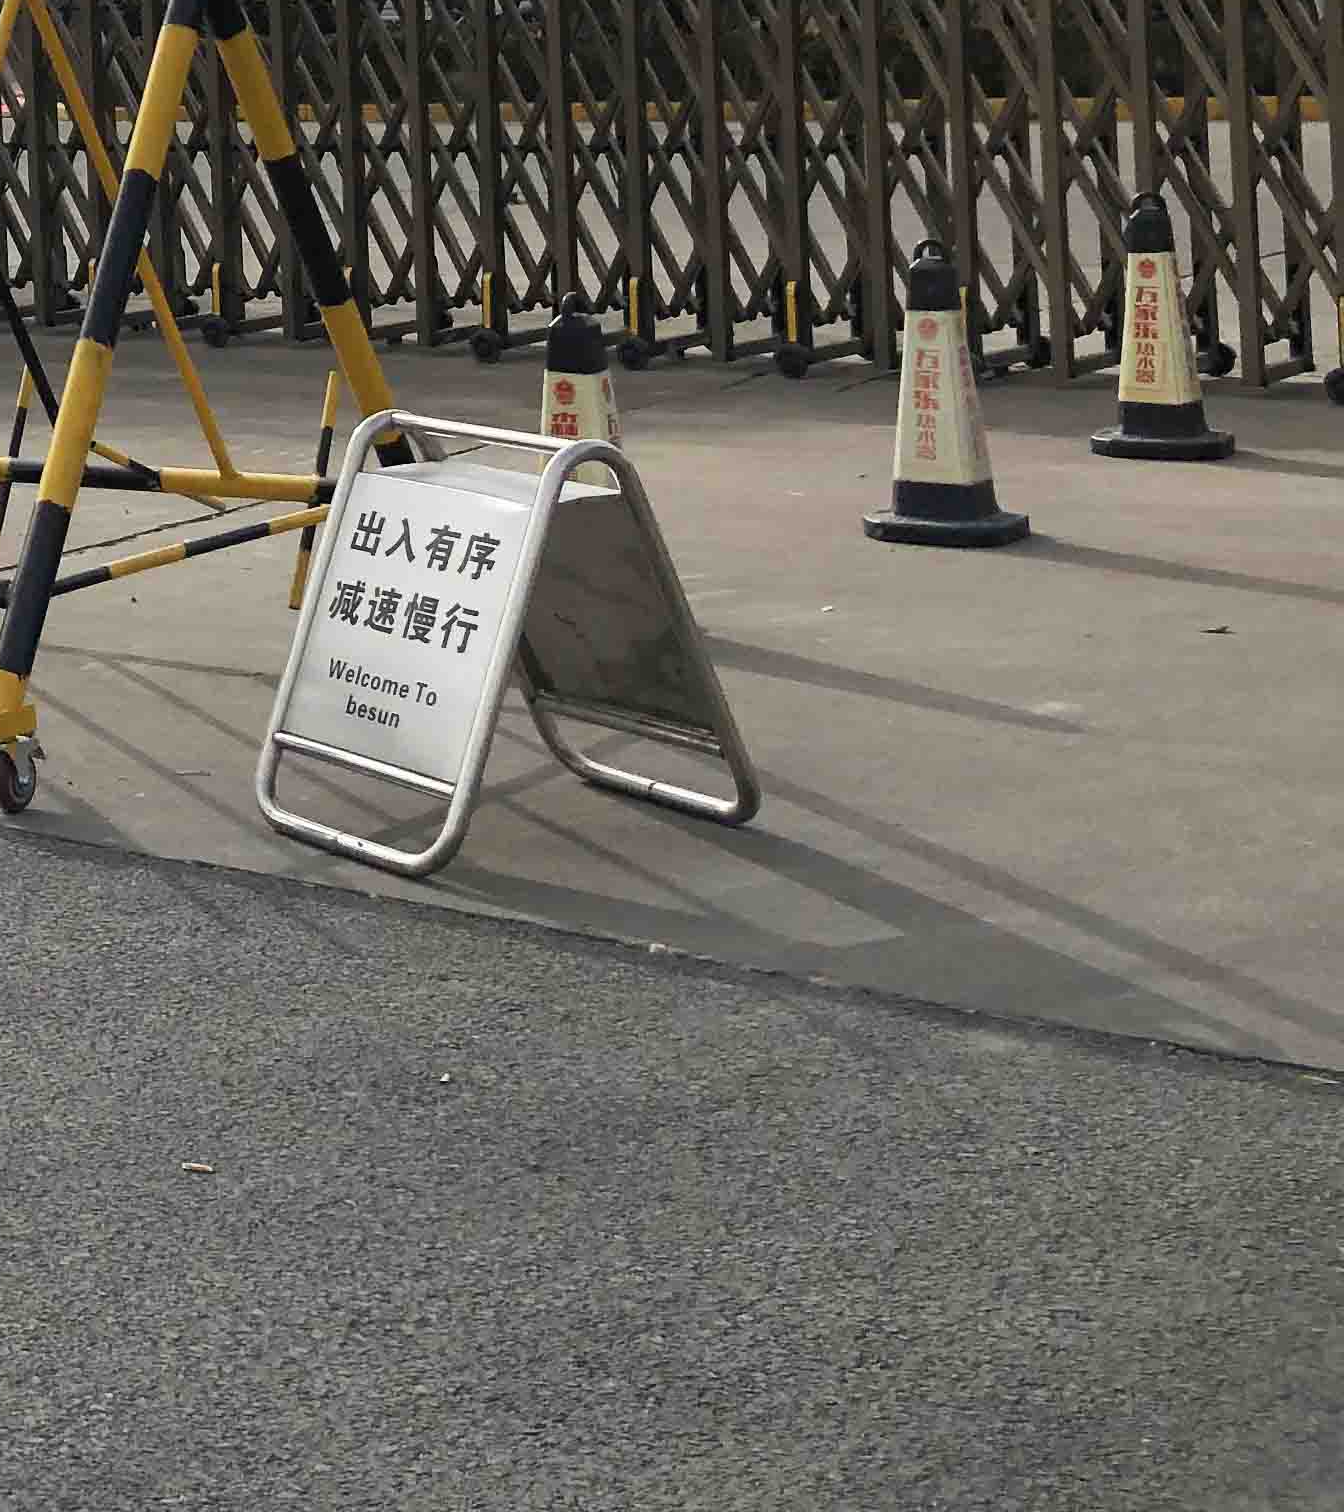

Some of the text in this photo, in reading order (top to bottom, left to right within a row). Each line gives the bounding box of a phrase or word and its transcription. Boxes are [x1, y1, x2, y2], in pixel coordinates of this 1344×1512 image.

[350, 510, 501, 580] 出入有序
[329, 580, 480, 654] 减速慢行
[328, 657, 438, 707] Welcome To
[345, 694, 401, 729] besun
